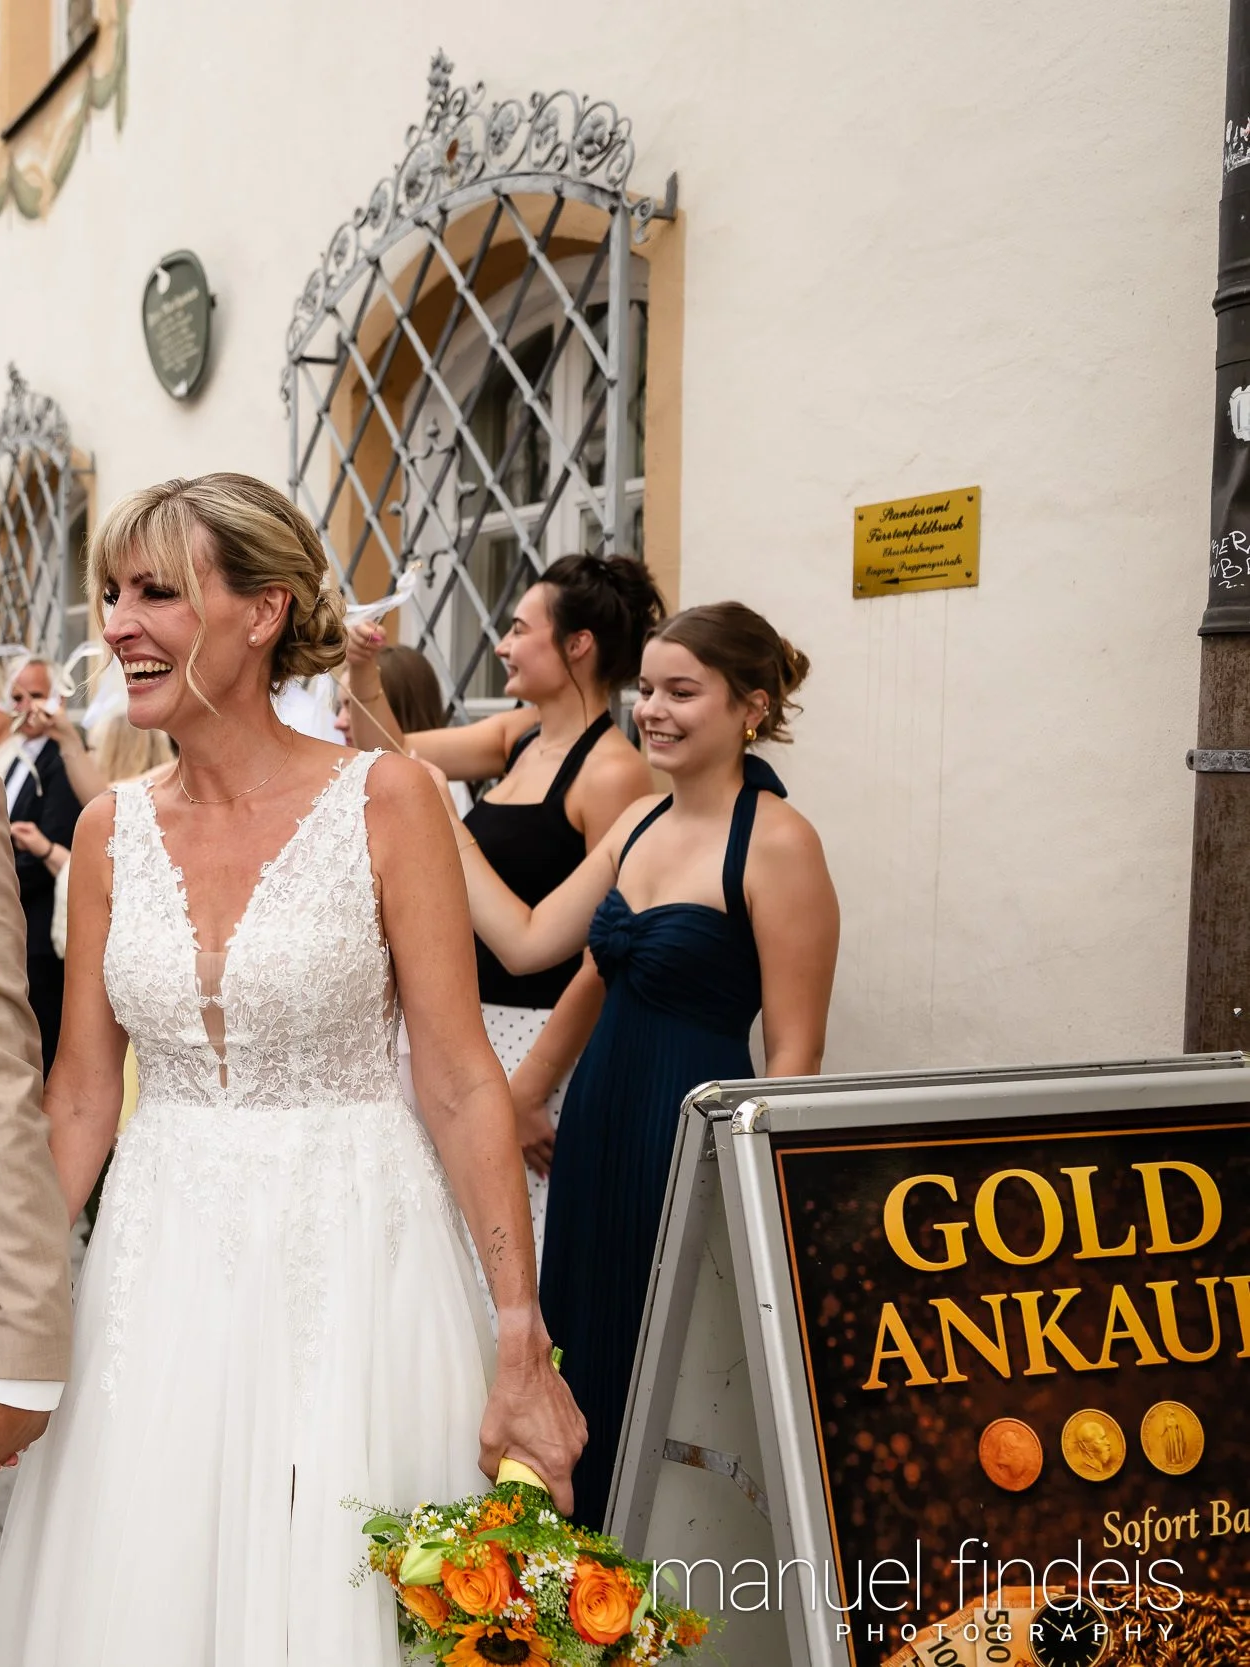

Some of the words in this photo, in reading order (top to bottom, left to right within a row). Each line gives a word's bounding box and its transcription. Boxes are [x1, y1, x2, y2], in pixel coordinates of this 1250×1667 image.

[883, 1160, 1223, 1272] GOLD
[1102, 1505, 1200, 1556] Sofort
[926, 1635, 968, 1667] 10
